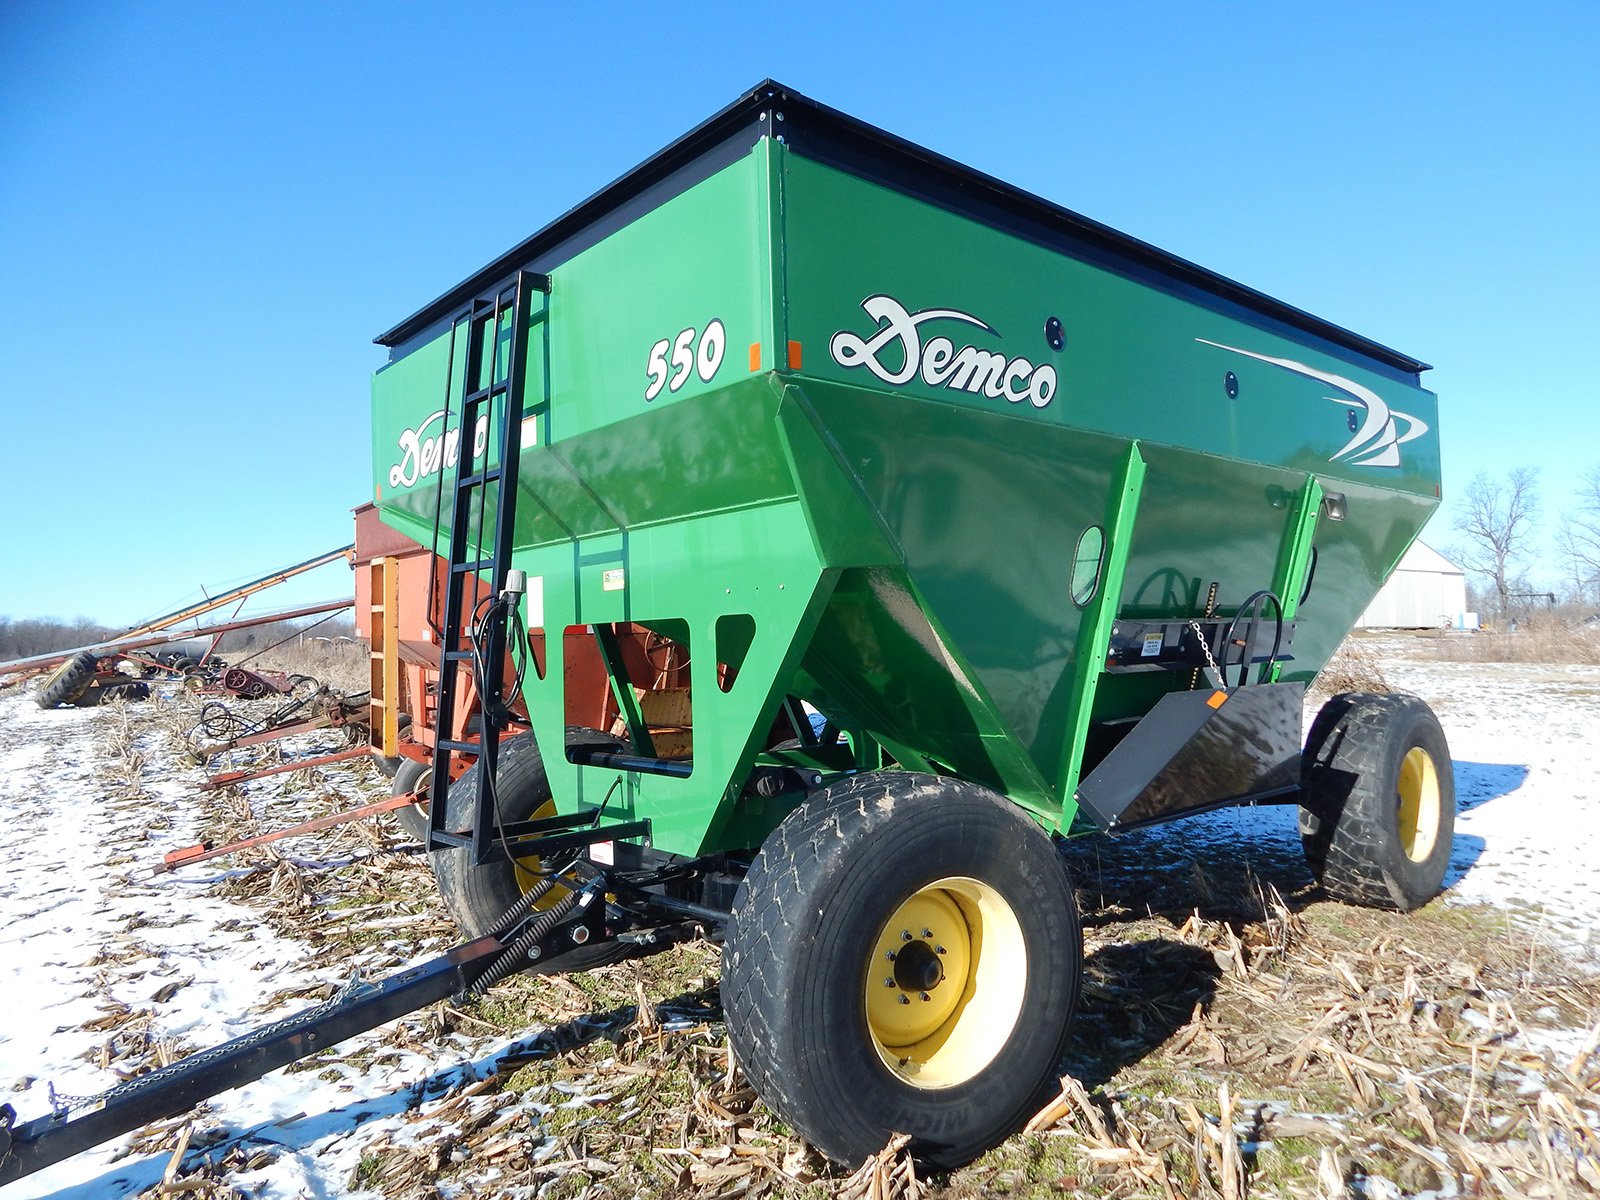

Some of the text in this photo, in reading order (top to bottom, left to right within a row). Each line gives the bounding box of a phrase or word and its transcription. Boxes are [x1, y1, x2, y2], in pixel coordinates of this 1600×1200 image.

[645, 317, 726, 402] 550
[829, 293, 1058, 409] Demco
[389, 409, 488, 488] Demo
